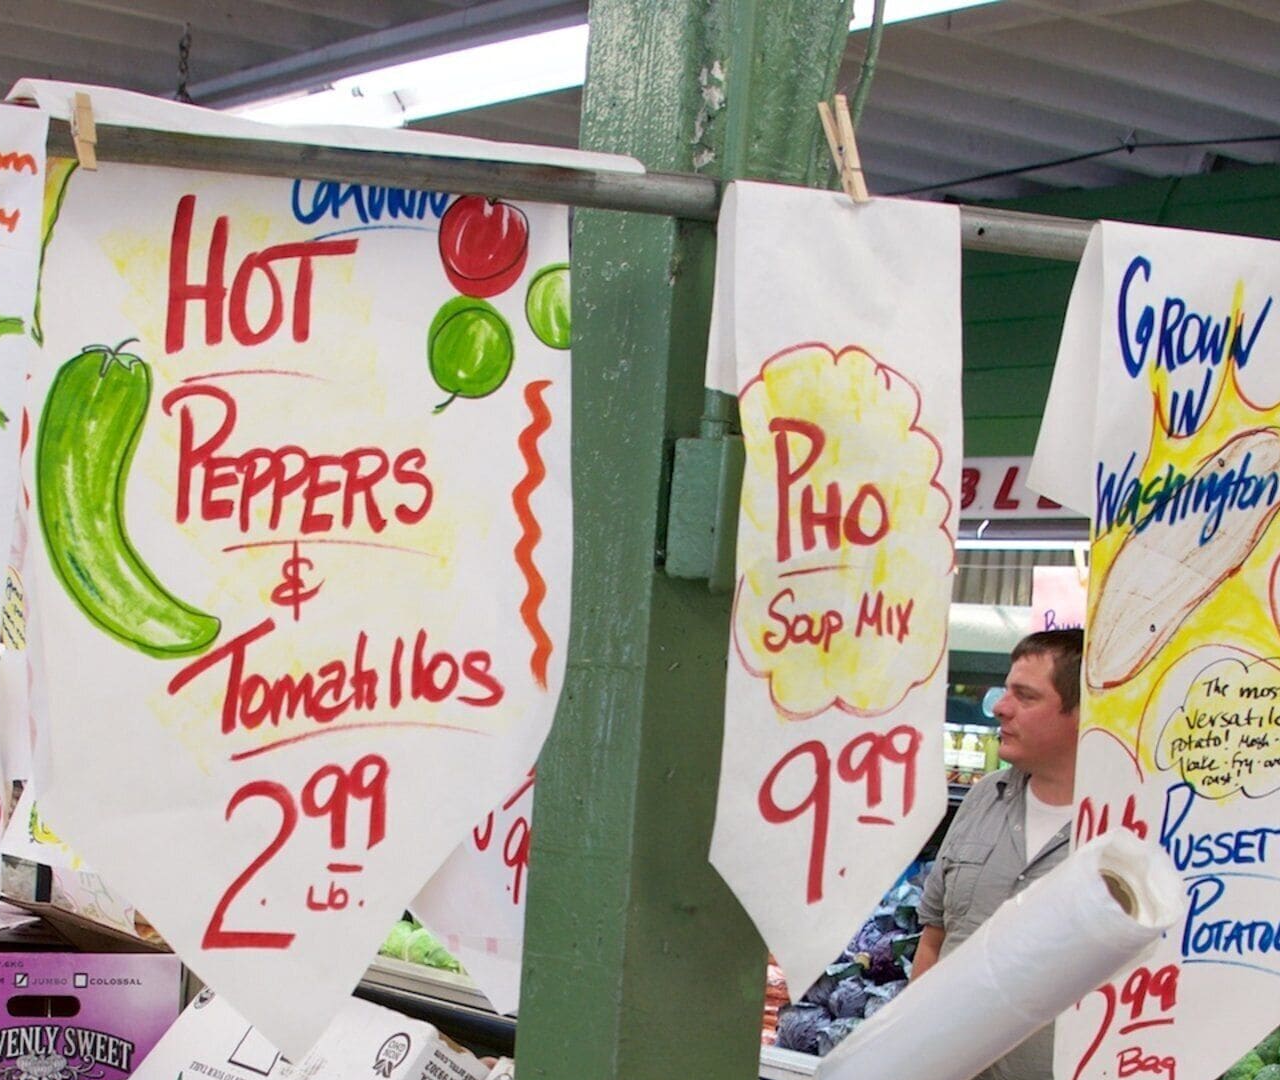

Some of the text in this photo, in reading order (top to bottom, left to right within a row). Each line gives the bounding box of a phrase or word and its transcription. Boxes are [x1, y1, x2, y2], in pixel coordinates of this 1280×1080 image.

[165, 194, 359, 354] HOT
[1119, 256, 1273, 378] GROWN
[1168, 368, 1213, 436] IN
[161, 383, 434, 534] PEPPERS
[769, 417, 889, 563] PHO
[1094, 452, 1279, 547] Washington
[270, 543, 325, 621] &
[167, 617, 505, 734] Tomatillos
[1203, 678, 1229, 698] The
[89, 976, 142, 987] COLOSSAL
[64, 1027, 135, 1074] SWEET
